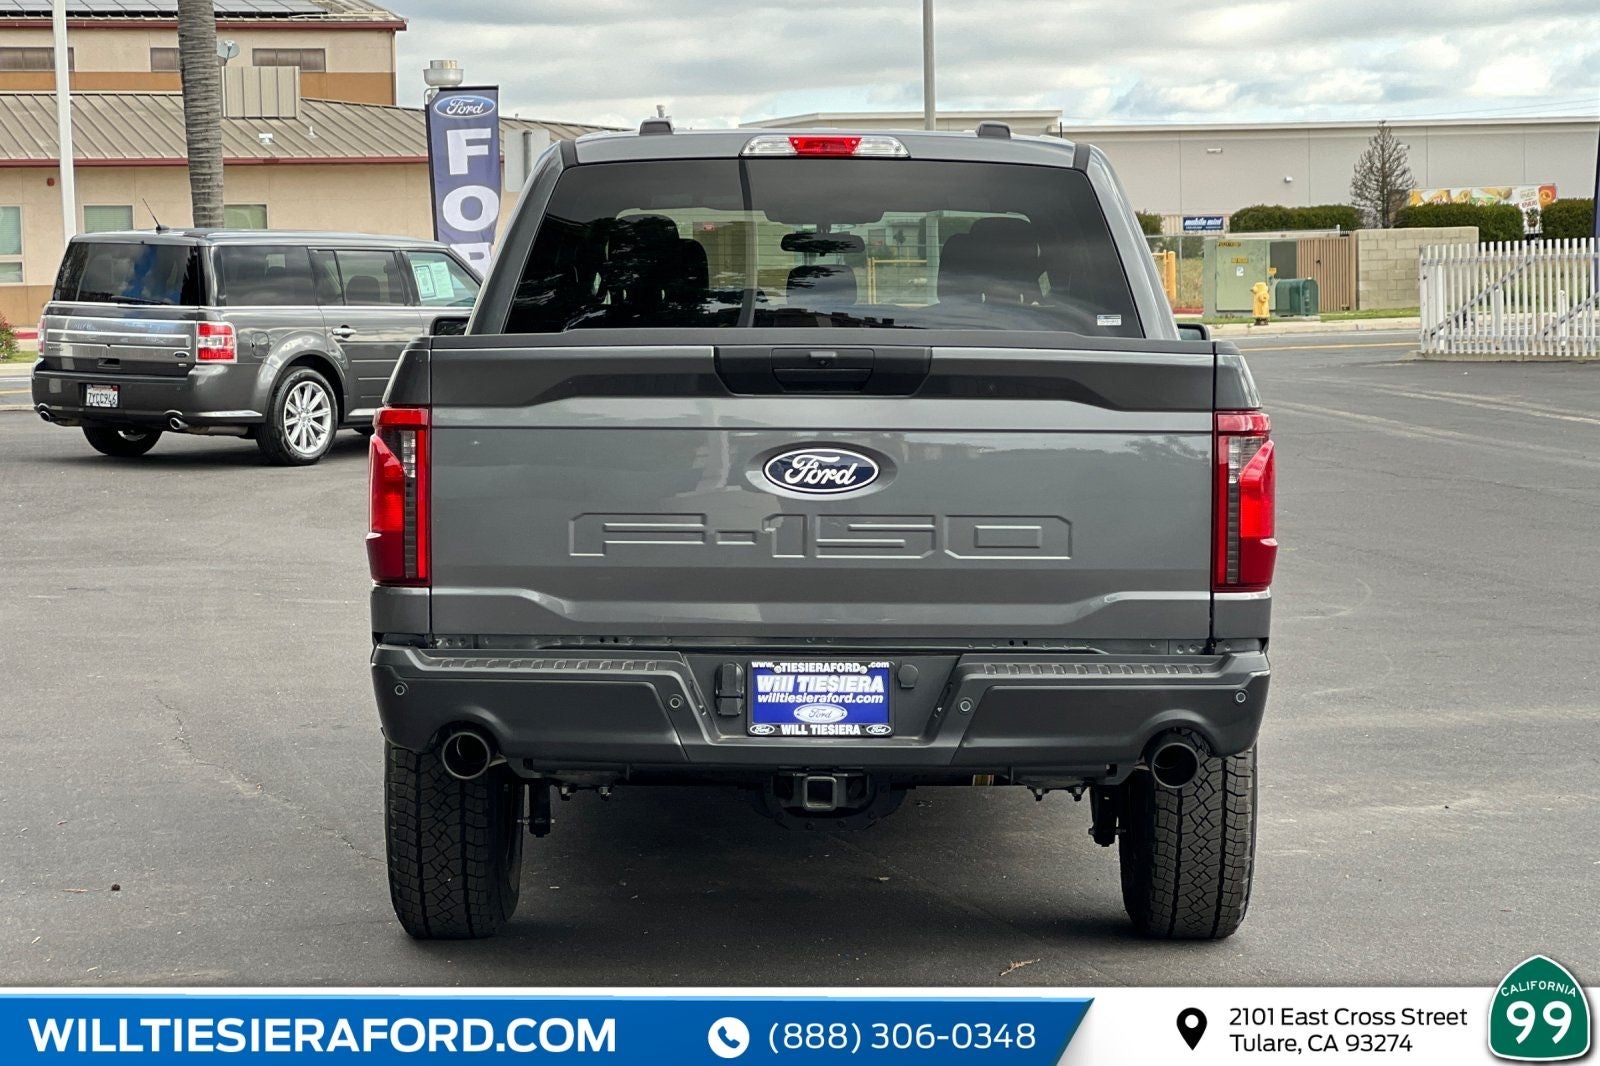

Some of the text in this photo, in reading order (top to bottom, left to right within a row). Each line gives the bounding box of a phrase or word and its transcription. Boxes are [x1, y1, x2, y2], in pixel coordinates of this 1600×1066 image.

[446, 97, 484, 114] Ford
[569, 512, 1073, 560] F-150
[781, 662, 861, 673] TIESIERAFORD
[797, 675, 884, 693] TIESIERA
[758, 693, 884, 704] willtiesieraford.com
[808, 708, 832, 719] Ford
[781, 725, 861, 735] WILL TIESIERA
